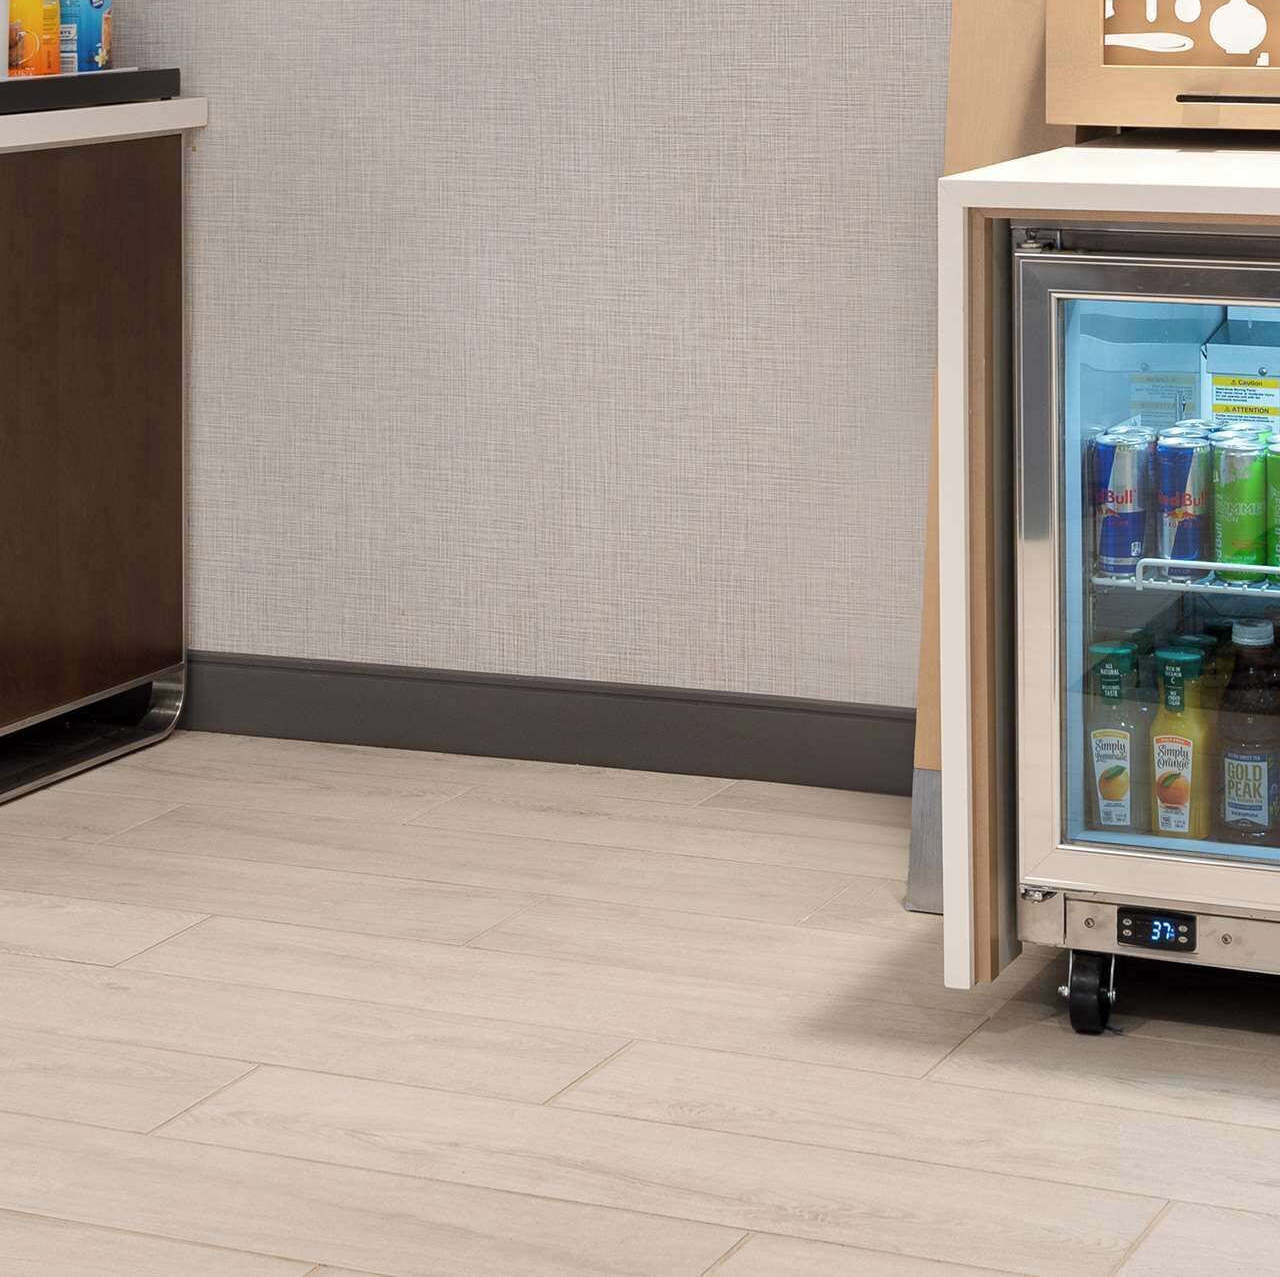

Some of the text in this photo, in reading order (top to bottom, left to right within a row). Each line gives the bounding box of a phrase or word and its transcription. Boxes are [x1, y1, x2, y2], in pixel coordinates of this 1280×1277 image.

[1095, 737, 1127, 754] Simply
[1157, 756, 1190, 771] Orange
[1227, 762, 1263, 782] GOLD
[1227, 779, 1264, 799] PEAK
[1151, 921, 1171, 941] 37
